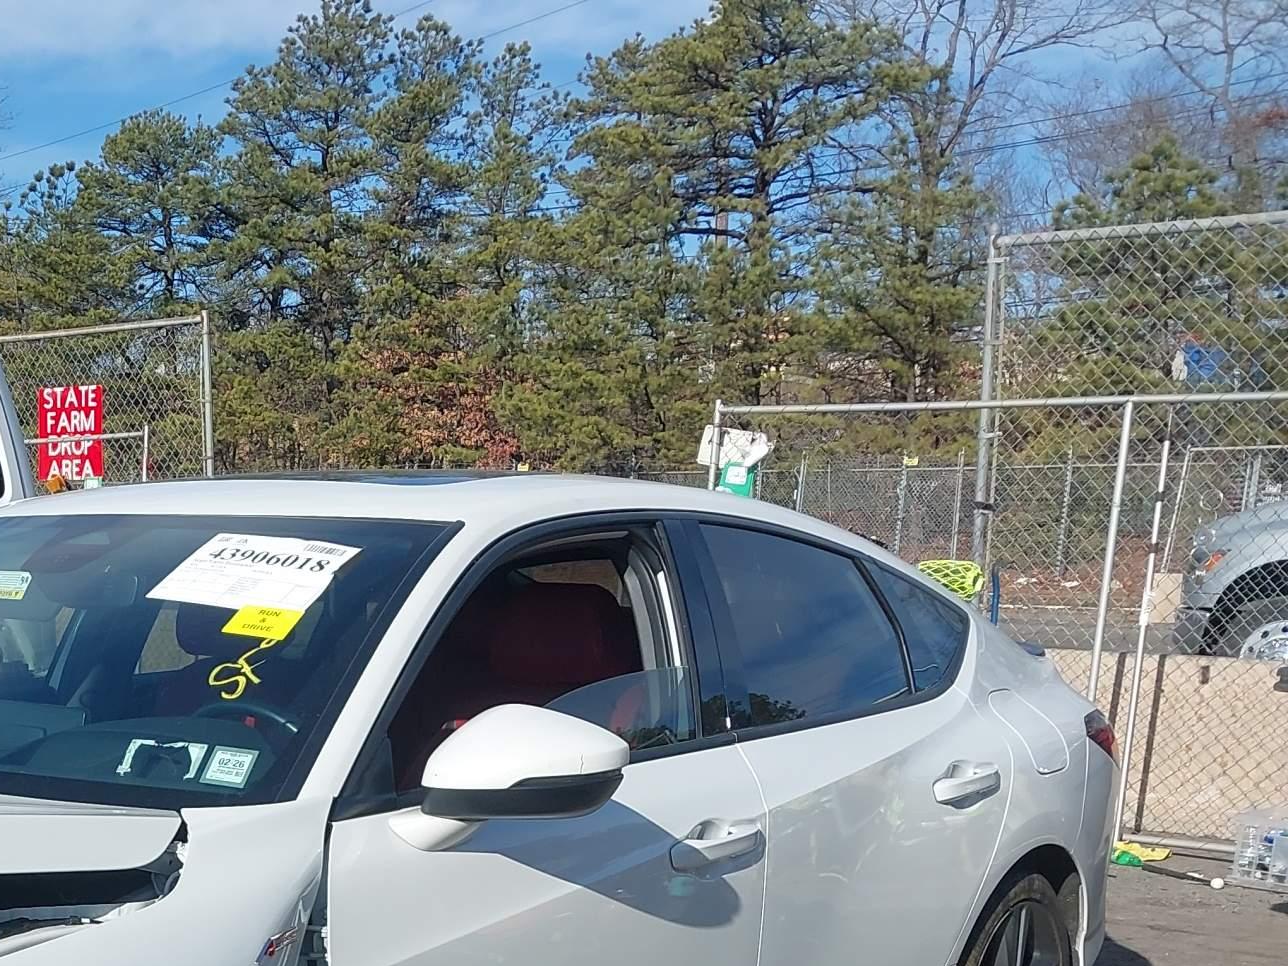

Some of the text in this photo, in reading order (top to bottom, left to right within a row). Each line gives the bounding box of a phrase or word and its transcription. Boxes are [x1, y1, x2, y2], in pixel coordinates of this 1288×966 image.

[43, 385, 97, 409] STATE
[47, 410, 95, 433] FARM
[48, 435, 92, 456] DROP
[48, 460, 94, 480] AREA
[209, 547, 331, 573] 43906018
[257, 609, 282, 617] RUN
[242, 623, 273, 632] DRIVE
